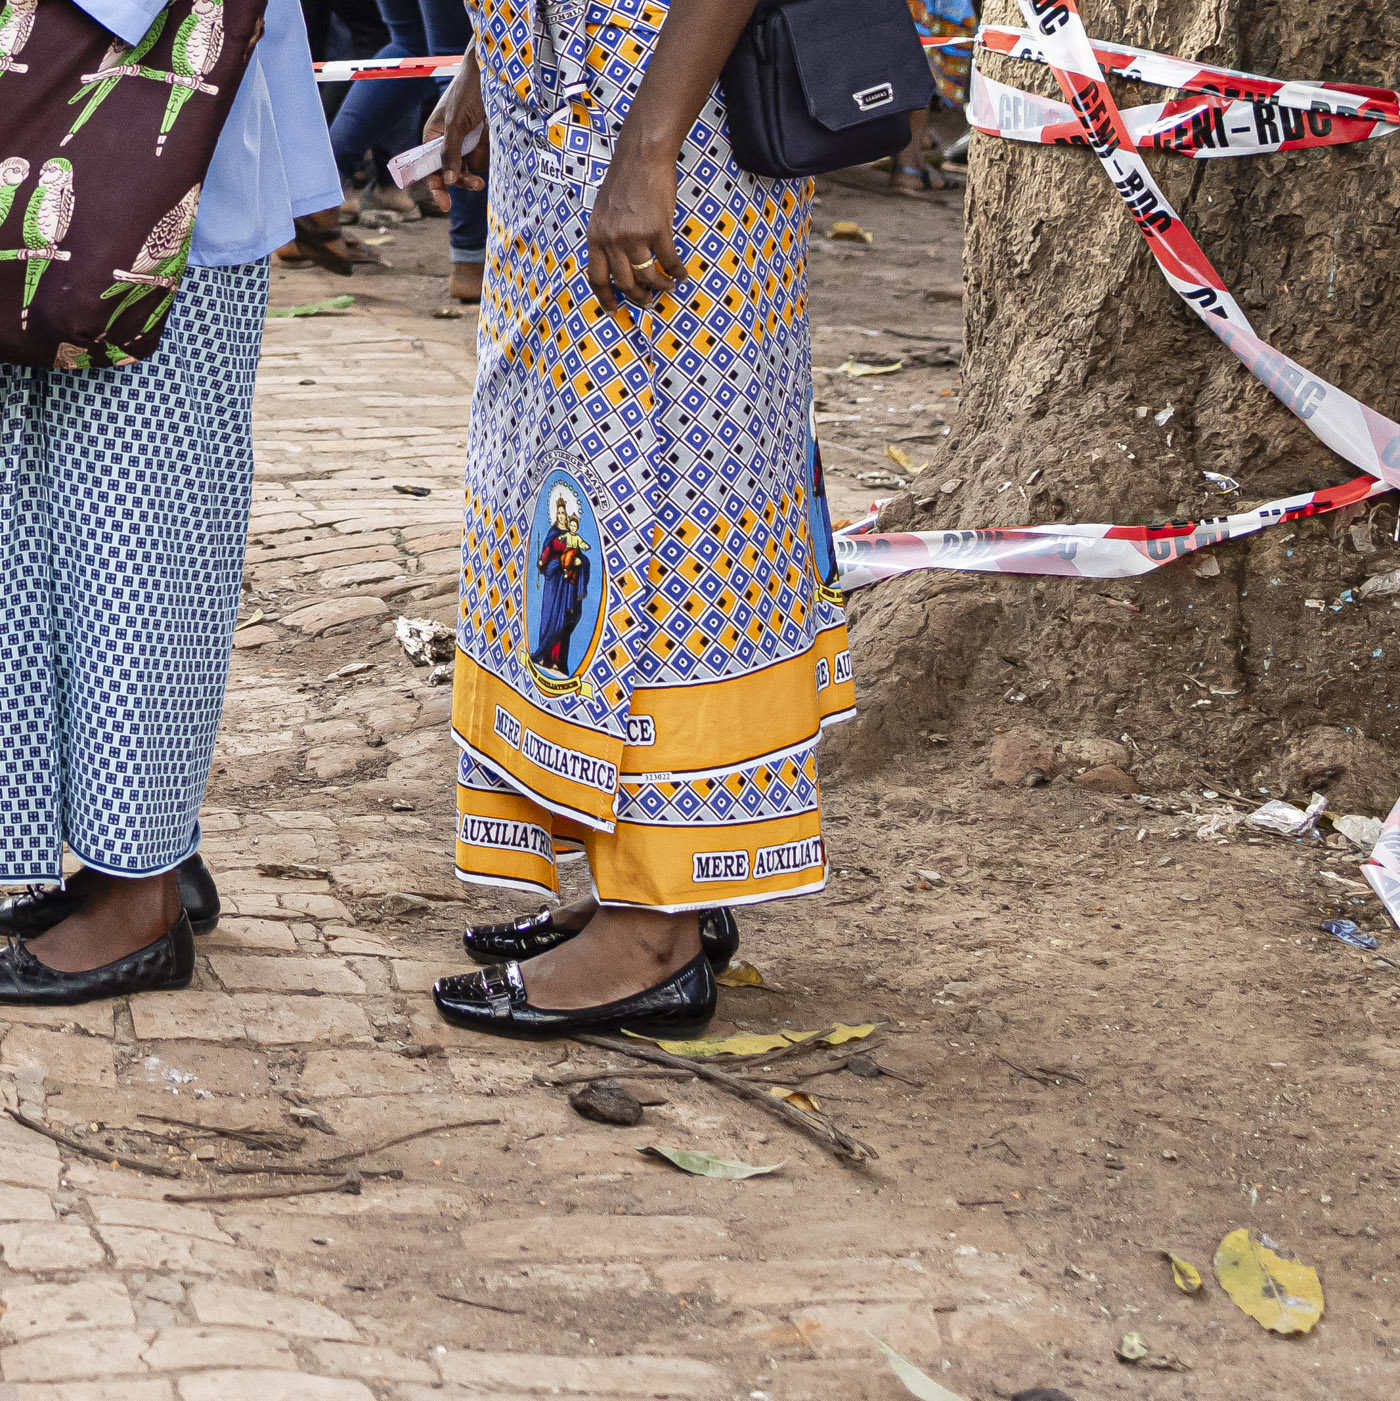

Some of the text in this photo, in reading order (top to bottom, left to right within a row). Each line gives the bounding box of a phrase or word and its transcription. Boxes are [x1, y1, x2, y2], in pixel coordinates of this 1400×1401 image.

[1154, 102, 1332, 149] CENI-RDC
[1072, 81, 1171, 238] CENI-RDC
[554, 451, 584, 469] VIERGE
[585, 468, 609, 509] MARIE
[495, 709, 615, 790] MERE AUXILIATRICE
[644, 773, 671, 782] 323022
[696, 854, 746, 879] MERE
